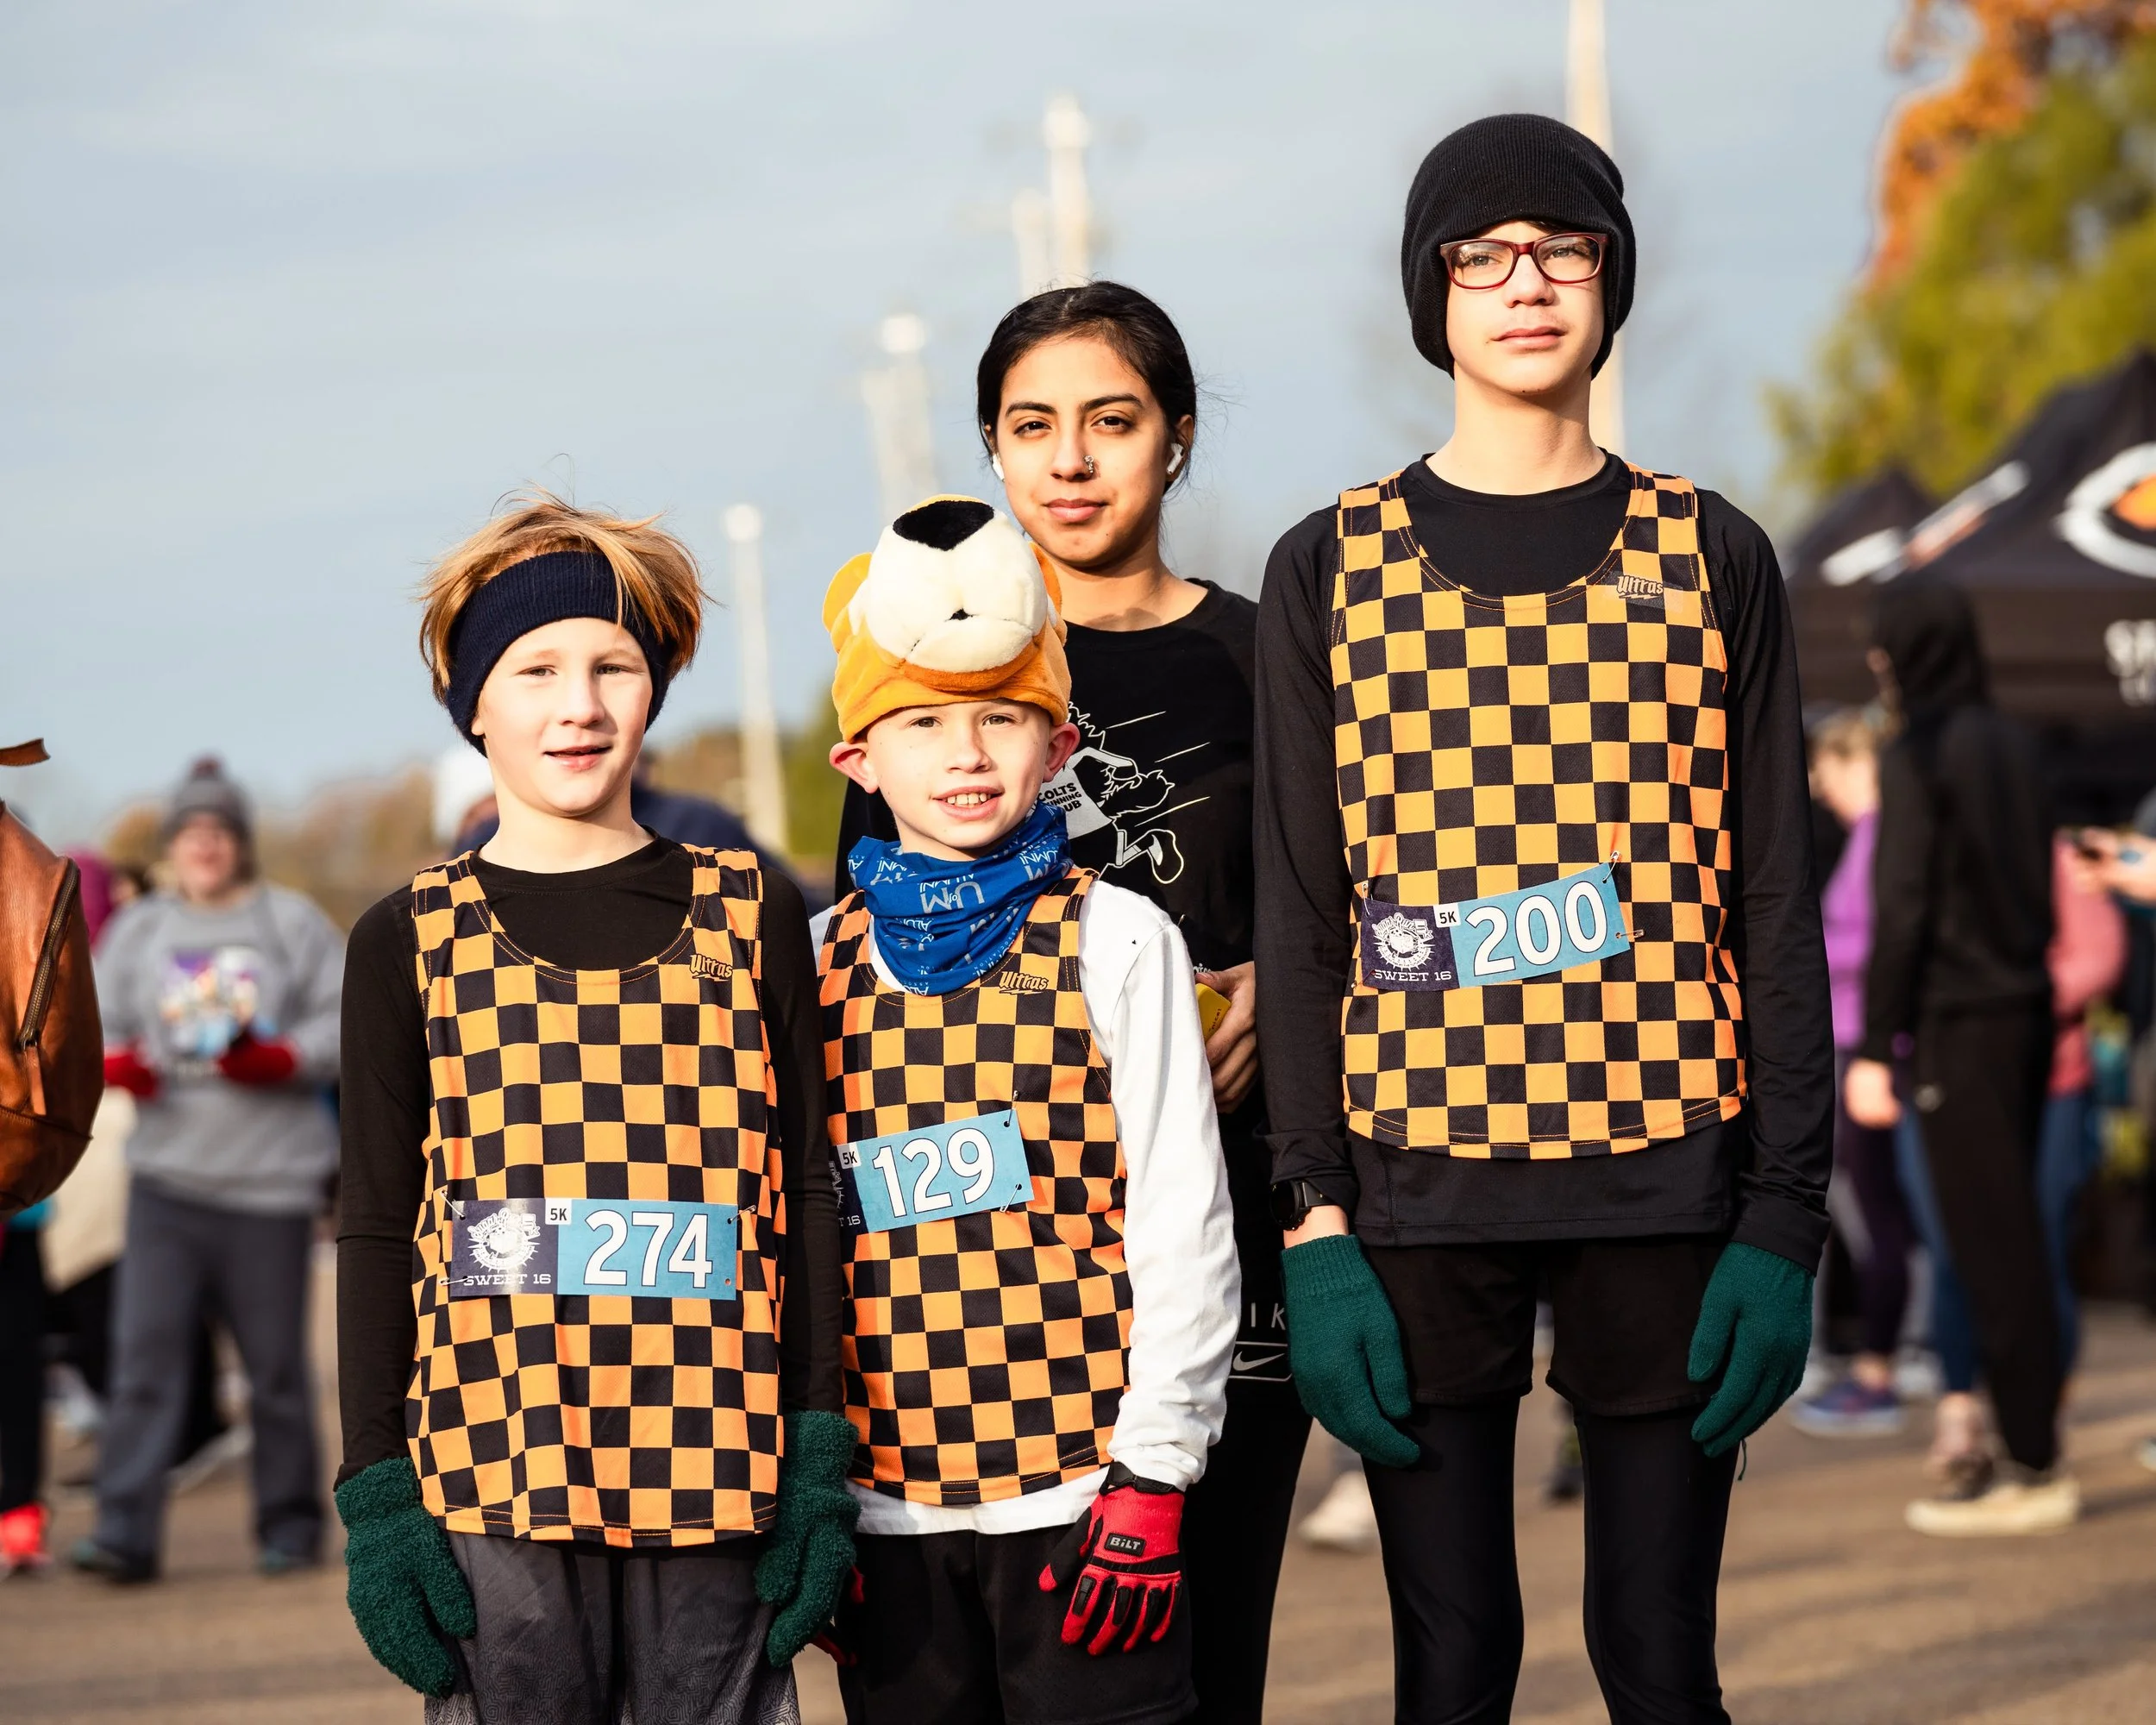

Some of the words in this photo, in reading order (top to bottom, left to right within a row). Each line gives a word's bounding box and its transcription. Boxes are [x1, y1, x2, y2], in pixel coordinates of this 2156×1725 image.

[1618, 575, 1664, 594] Ultras
[1037, 782, 1077, 801] COLTS
[1063, 800, 1082, 812] UB
[1438, 911, 1457, 925] 5K
[1464, 880, 1608, 977] 200
[690, 953, 733, 978] Ultras
[999, 970, 1049, 990] Ultras
[1374, 969, 1429, 982] SWEET
[1433, 970, 1452, 981] 16
[842, 1150, 858, 1165] 5K
[871, 1127, 995, 1219] 129
[549, 1207, 568, 1221] 5K
[847, 1214, 862, 1226] 16
[583, 1208, 713, 1289] 274
[532, 1273, 552, 1284] 16
[1250, 1302, 1286, 1330] IK
